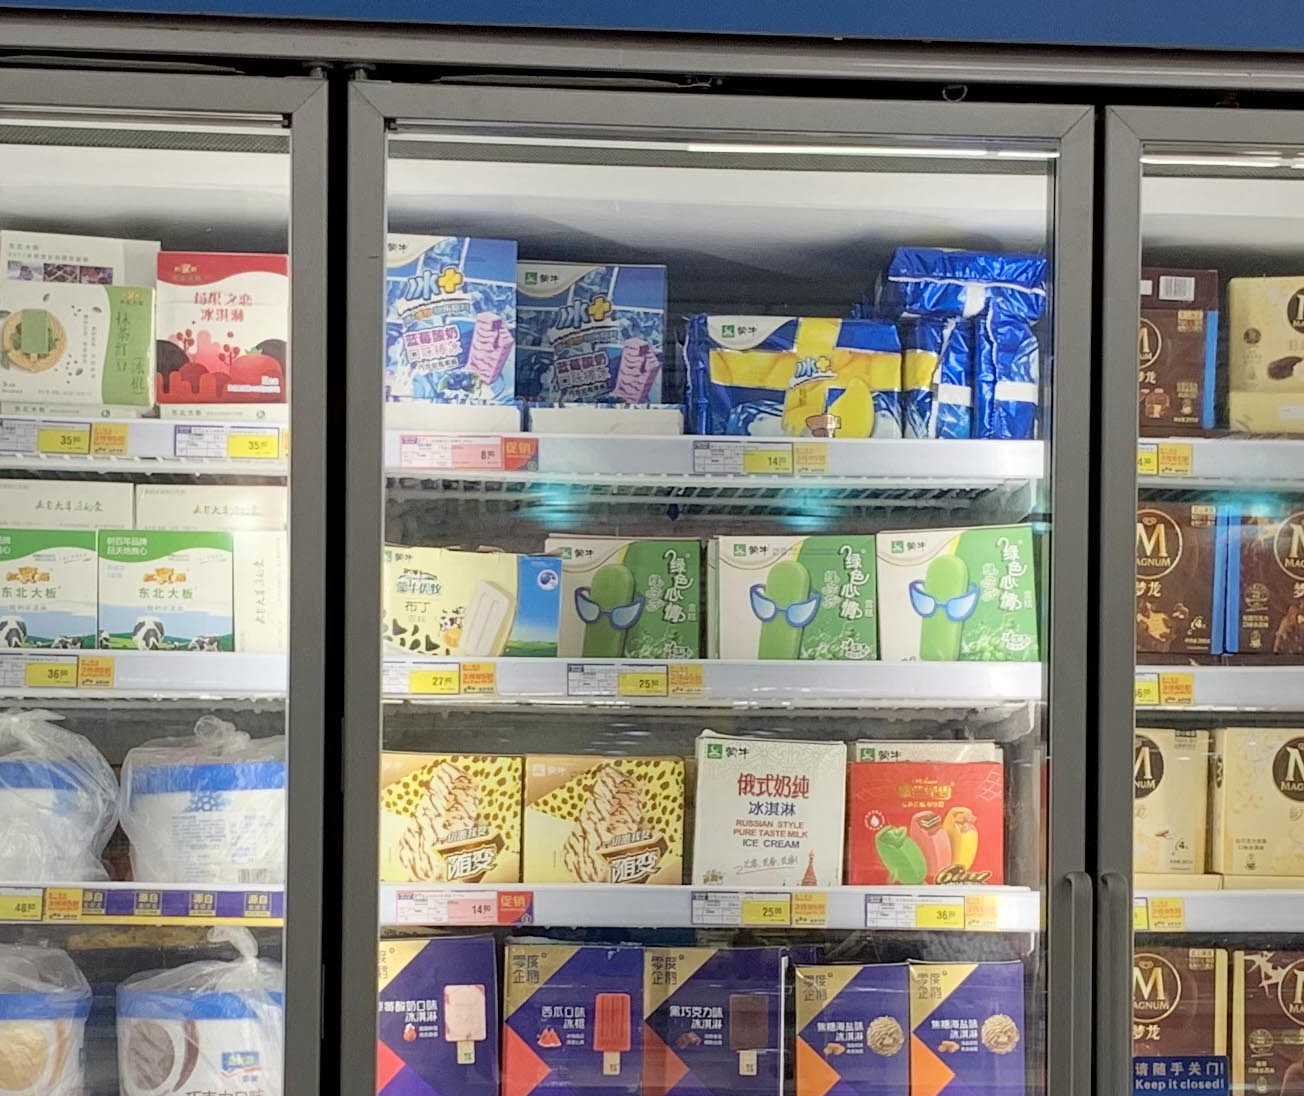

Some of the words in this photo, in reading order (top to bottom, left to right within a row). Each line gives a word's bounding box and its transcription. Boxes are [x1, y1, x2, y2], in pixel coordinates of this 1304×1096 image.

[200, 309, 245, 322] 冰淇淋
[404, 326, 459, 346] 蓝莓酸奶
[738, 326, 756, 336] 蒙牛
[555, 354, 606, 373] 蓝莓酸奶
[749, 545, 767, 555] 蒙牛
[906, 541, 926, 550] 蒙牛
[996, 537, 1027, 612] 绿色心情
[841, 545, 869, 620] 绿色心情
[2, 586, 57, 599] 东北大板
[139, 587, 193, 599] 东北大板
[405, 602, 430, 613] 布丁
[726, 747, 749, 759] 蒙牛
[878, 750, 901, 760] 蒙牛
[737, 773, 809, 799] 俄式奶纯
[748, 802, 795, 817] 冰淇淋
[736, 819, 774, 829] RUSSIAN
[778, 820, 804, 829] STYLE
[734, 828, 756, 837] PURE
[759, 829, 786, 838] TASTE
[788, 830, 808, 838] MILK
[742, 839, 759, 847] ICE
[764, 840, 800, 849] CREAM
[447, 849, 496, 881] 随变
[612, 850, 659, 883] 随变
[501, 895, 525, 908] 促销
[542, 1007, 586, 1018] 西瓜口味
[670, 1005, 723, 1018] 黑巧克力味
[405, 1013, 438, 1022] 冰淇淋
[563, 1019, 585, 1029] 冰棍
[691, 1019, 723, 1030] 冰淇淋
[817, 1021, 864, 1032] 焦糖海盐味
[931, 1019, 978, 1030] 焦糖海盐味
[835, 1031, 864, 1041] 冰淇淋
[949, 1029, 978, 1040] 冰淇淋
[1135, 1063, 1224, 1076] 请随手关门!
[1135, 1079, 1165, 1091] Keep
[1168, 1079, 1177, 1089] it
[1180, 1078, 1224, 1090] closed!
